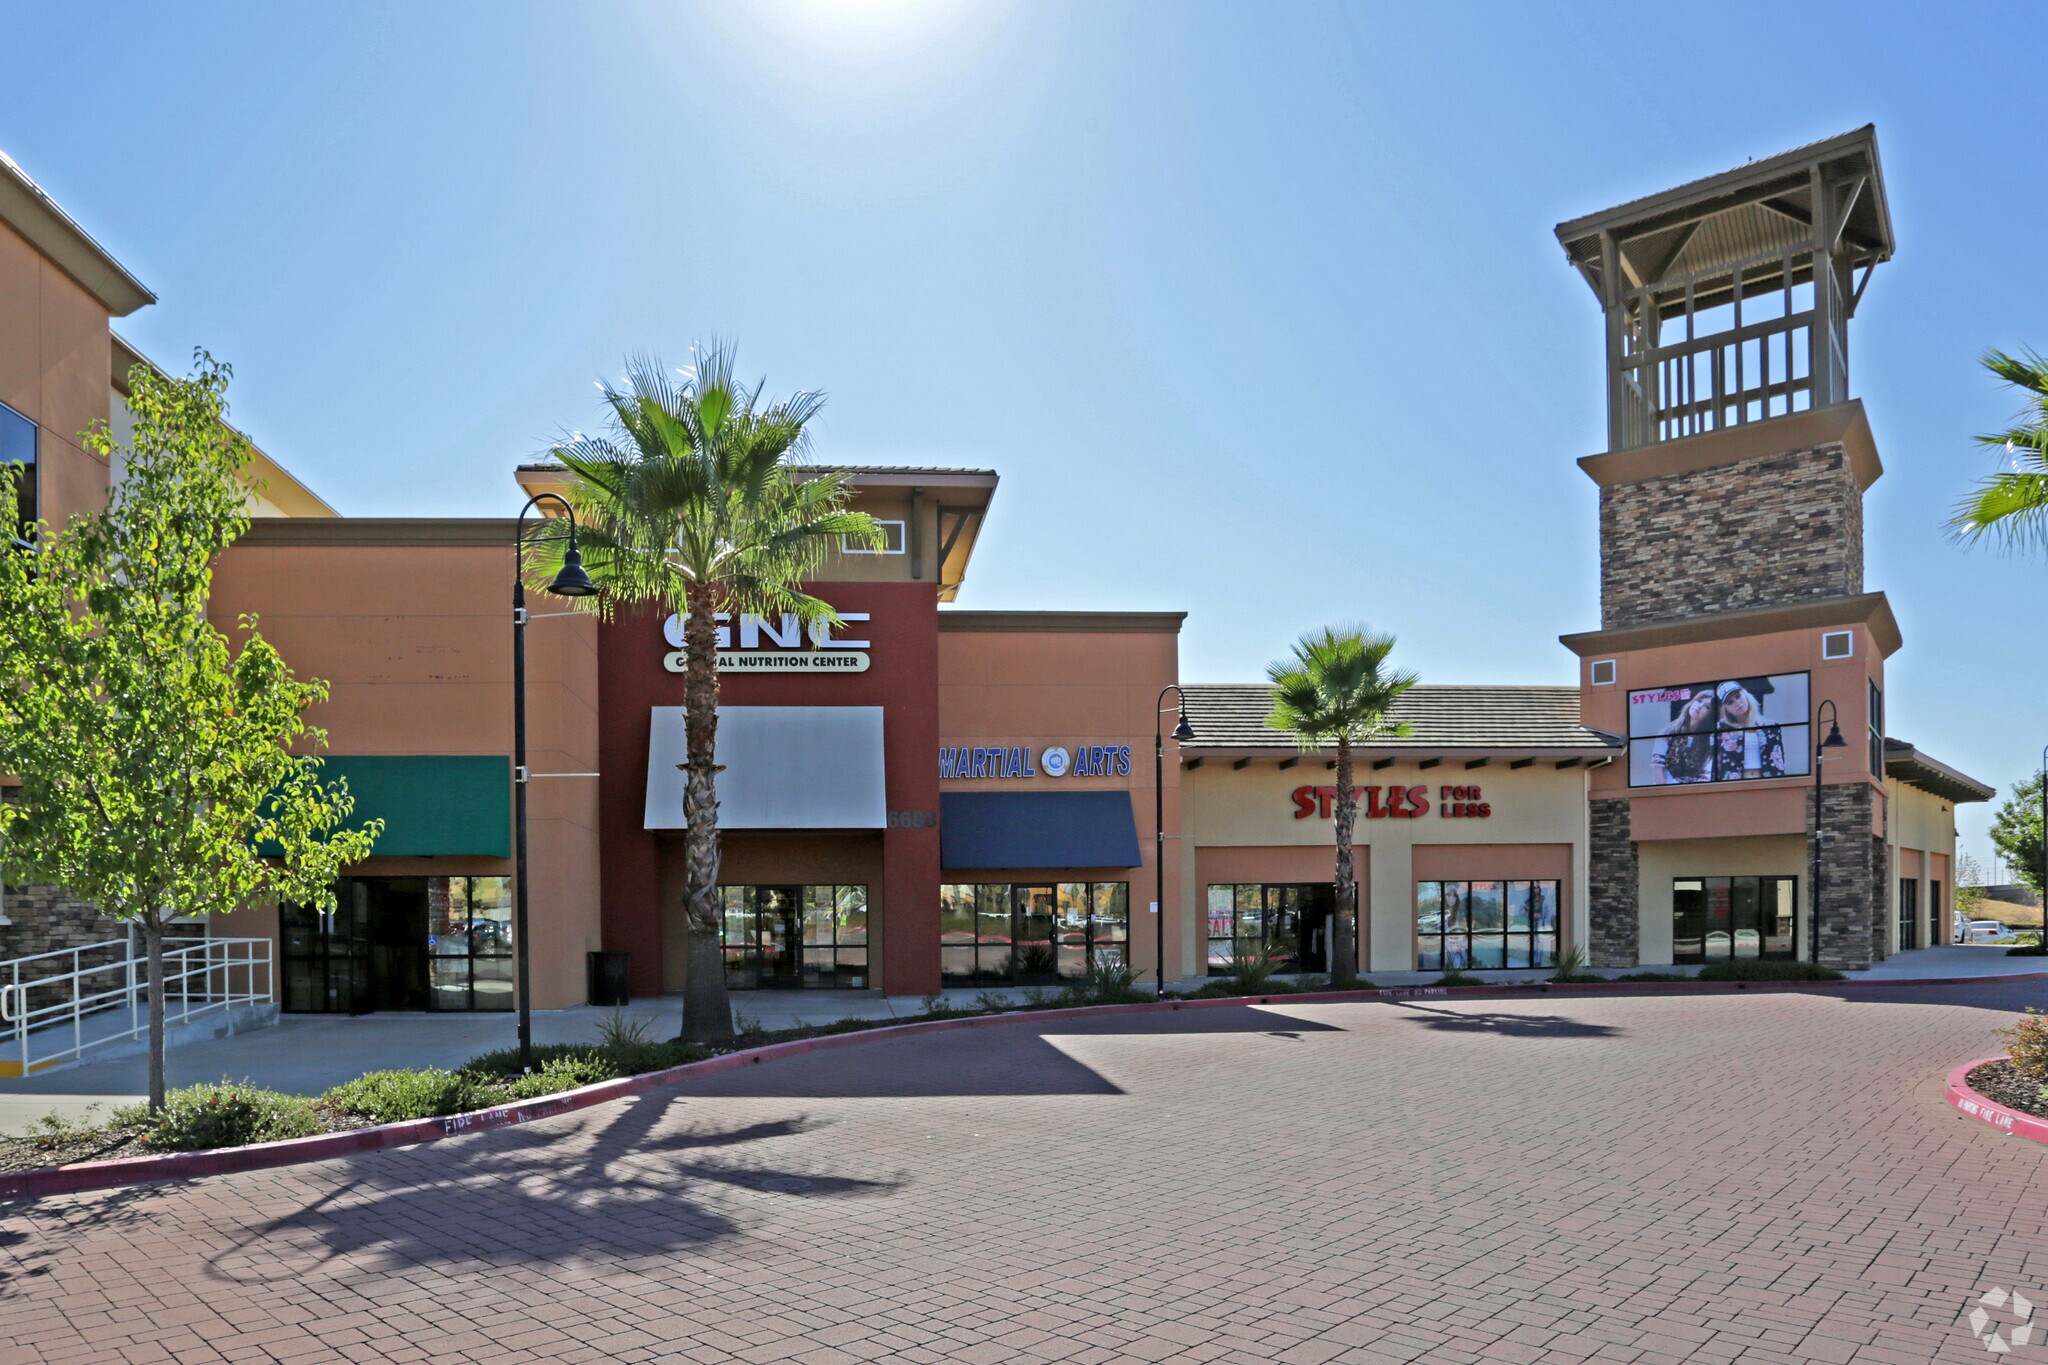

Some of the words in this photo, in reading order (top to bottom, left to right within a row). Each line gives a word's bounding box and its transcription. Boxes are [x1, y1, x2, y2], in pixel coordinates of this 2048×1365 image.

[738, 657, 809, 667] NUTRITION
[812, 656, 859, 667] CENTER
[1632, 689, 1680, 705] STYLES
[938, 747, 1036, 779] MARTIAL
[1072, 745, 1132, 777] ARTS
[1440, 785, 1483, 800] FOR
[1440, 803, 1492, 817] LESS
